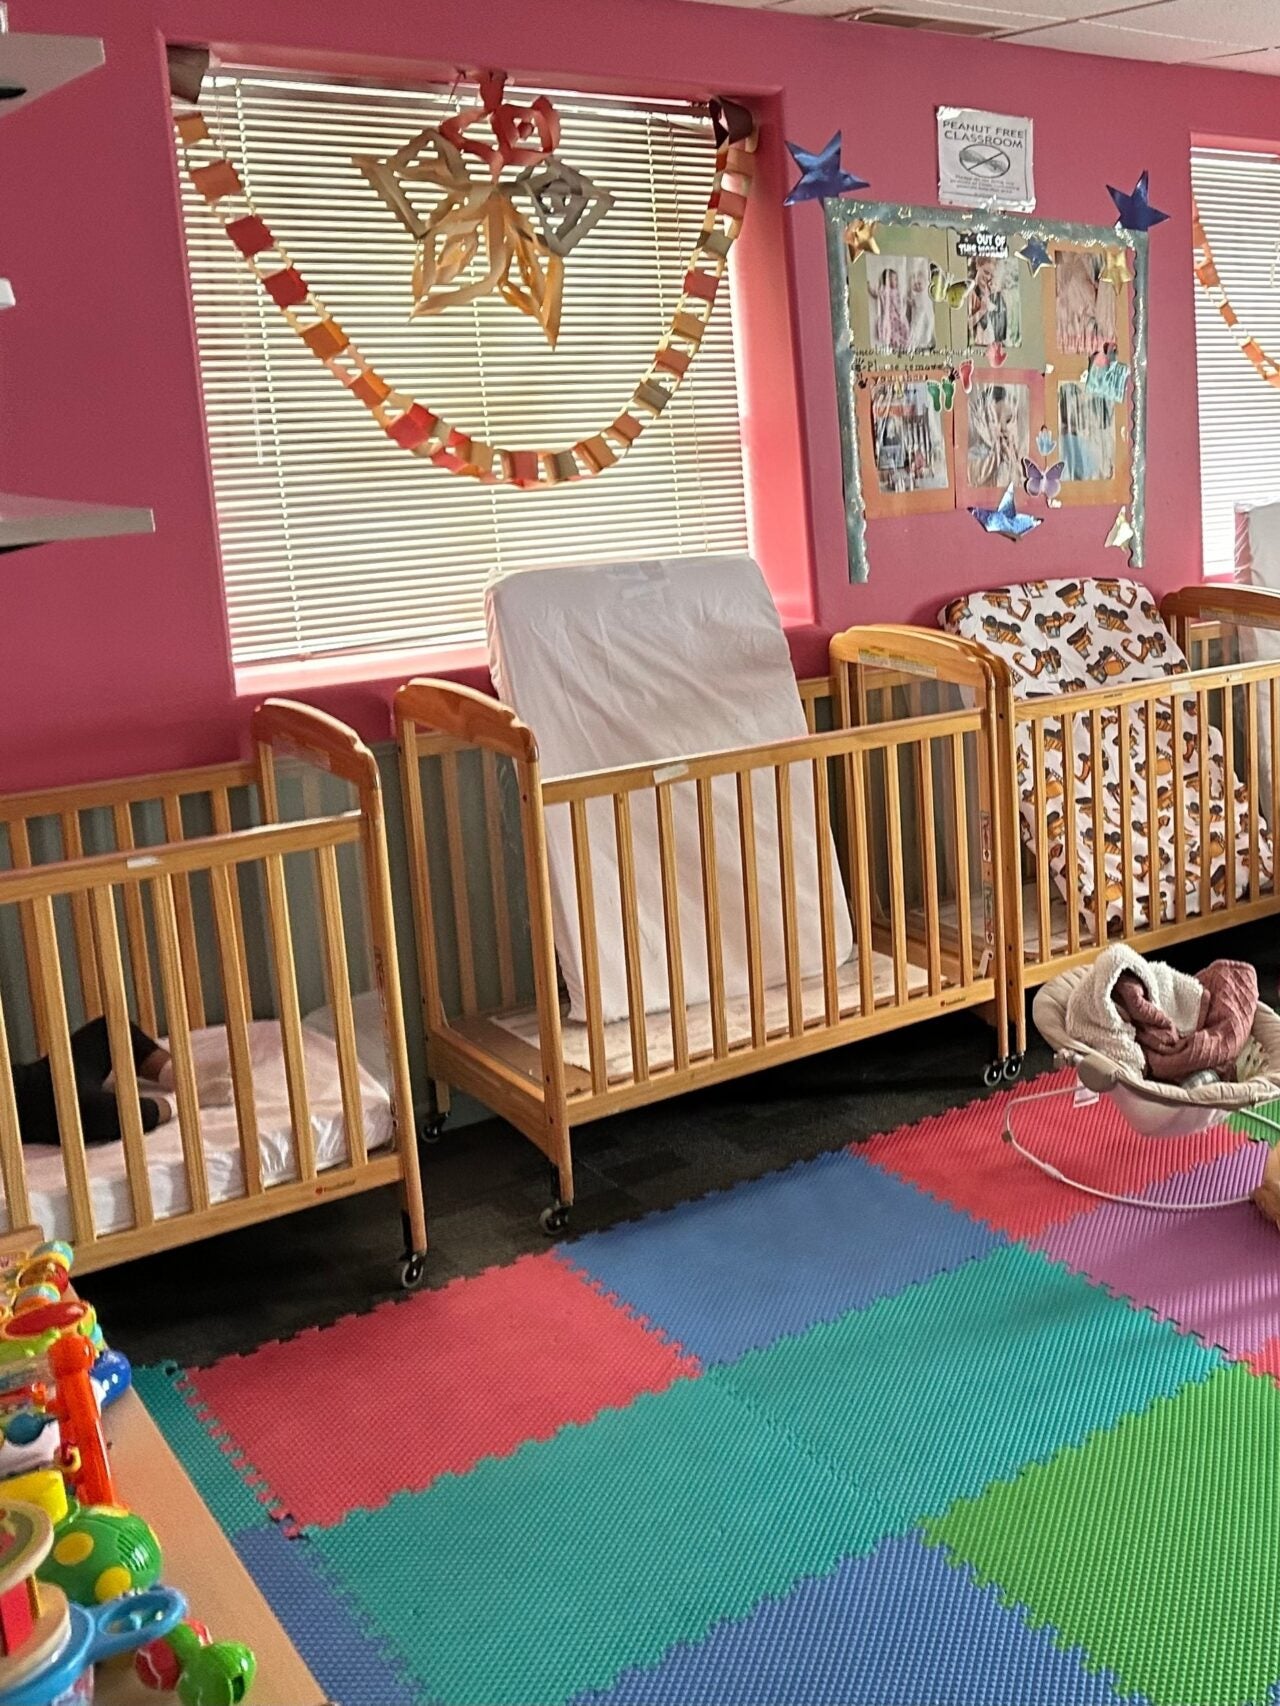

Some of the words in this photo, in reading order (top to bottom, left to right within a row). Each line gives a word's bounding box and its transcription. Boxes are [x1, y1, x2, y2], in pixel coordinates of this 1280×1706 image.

[943, 120, 991, 134] PEANUT
[995, 127, 1024, 139] FREE
[944, 131, 1023, 148] CLASSROOM
[976, 233, 993, 246] OUT
